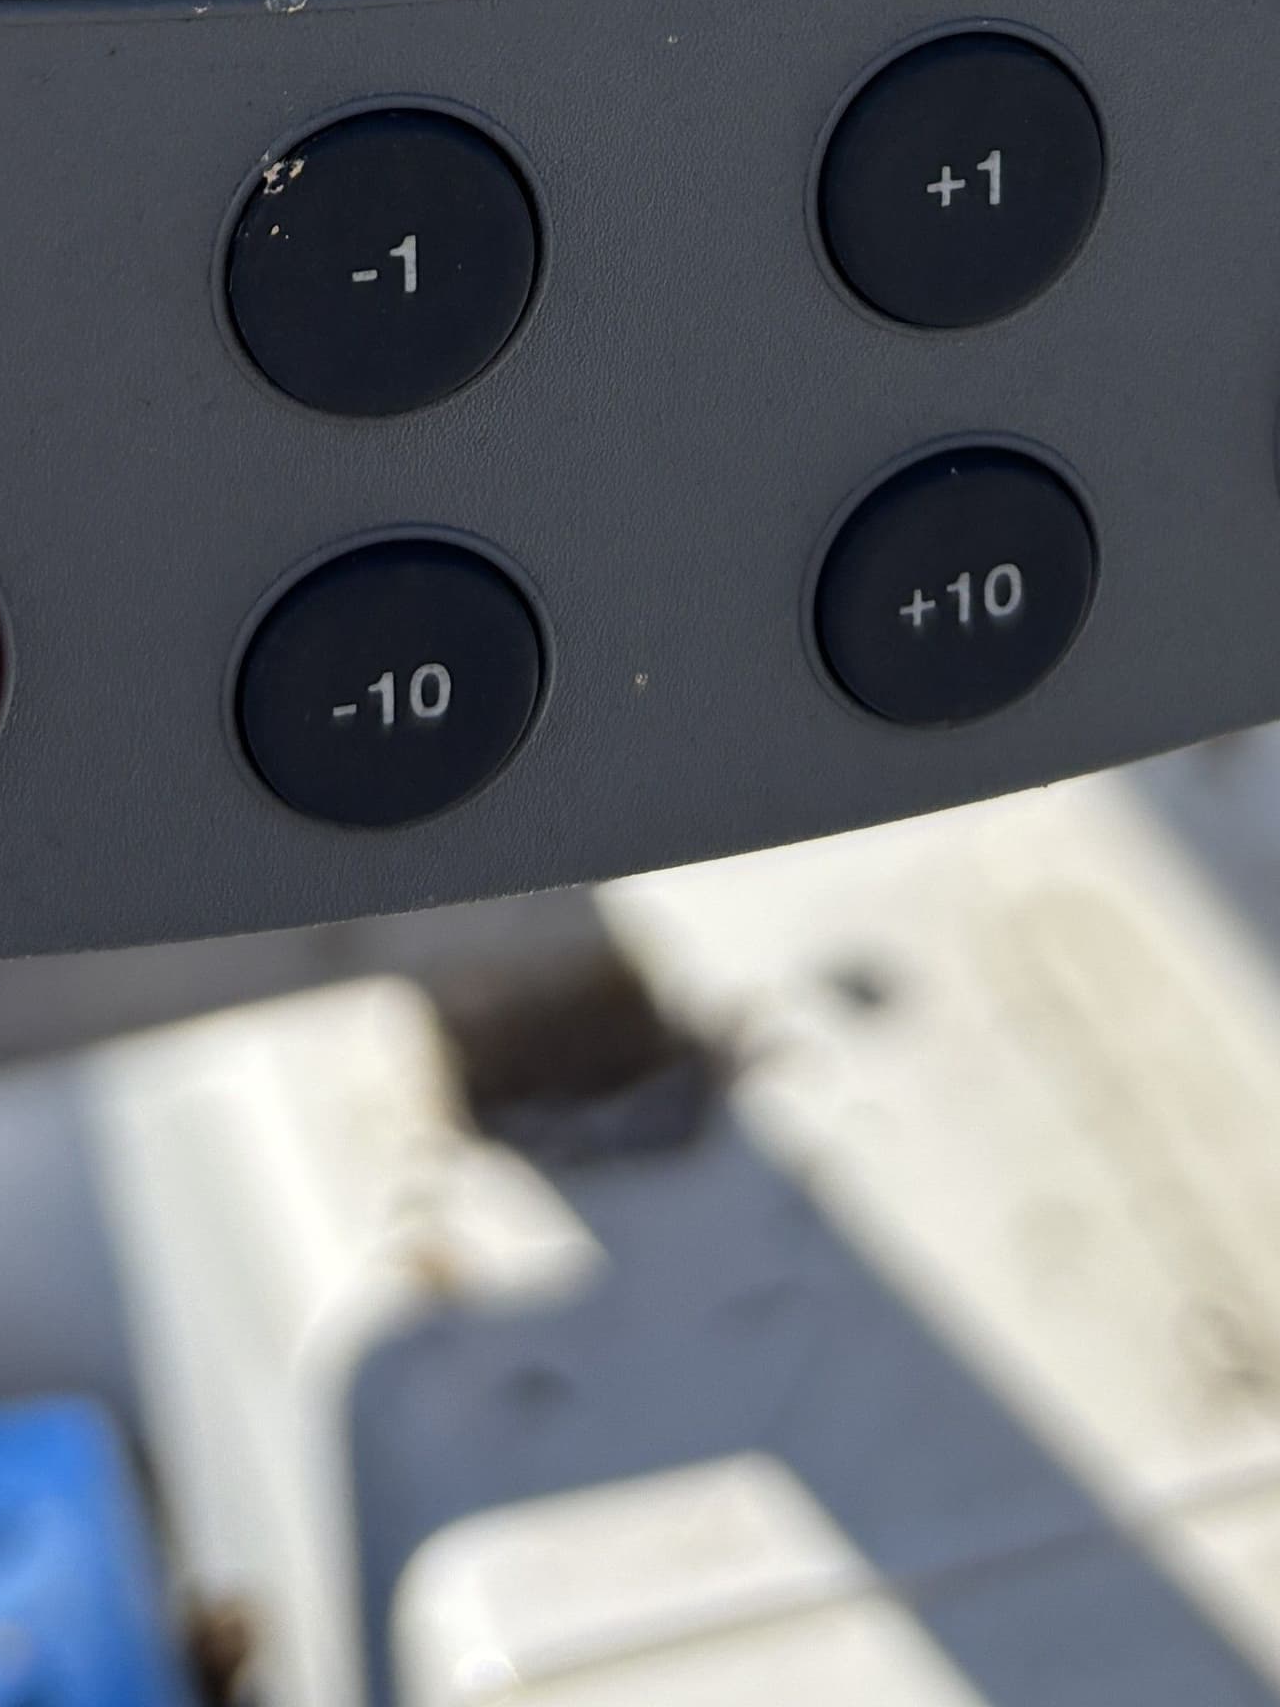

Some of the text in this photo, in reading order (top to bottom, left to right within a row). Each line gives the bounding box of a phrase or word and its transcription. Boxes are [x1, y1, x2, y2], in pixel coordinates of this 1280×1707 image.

[926, 150, 1001, 207] +1
[352, 235, 417, 293] -1
[899, 563, 1022, 627] +10
[332, 663, 451, 725] -10
